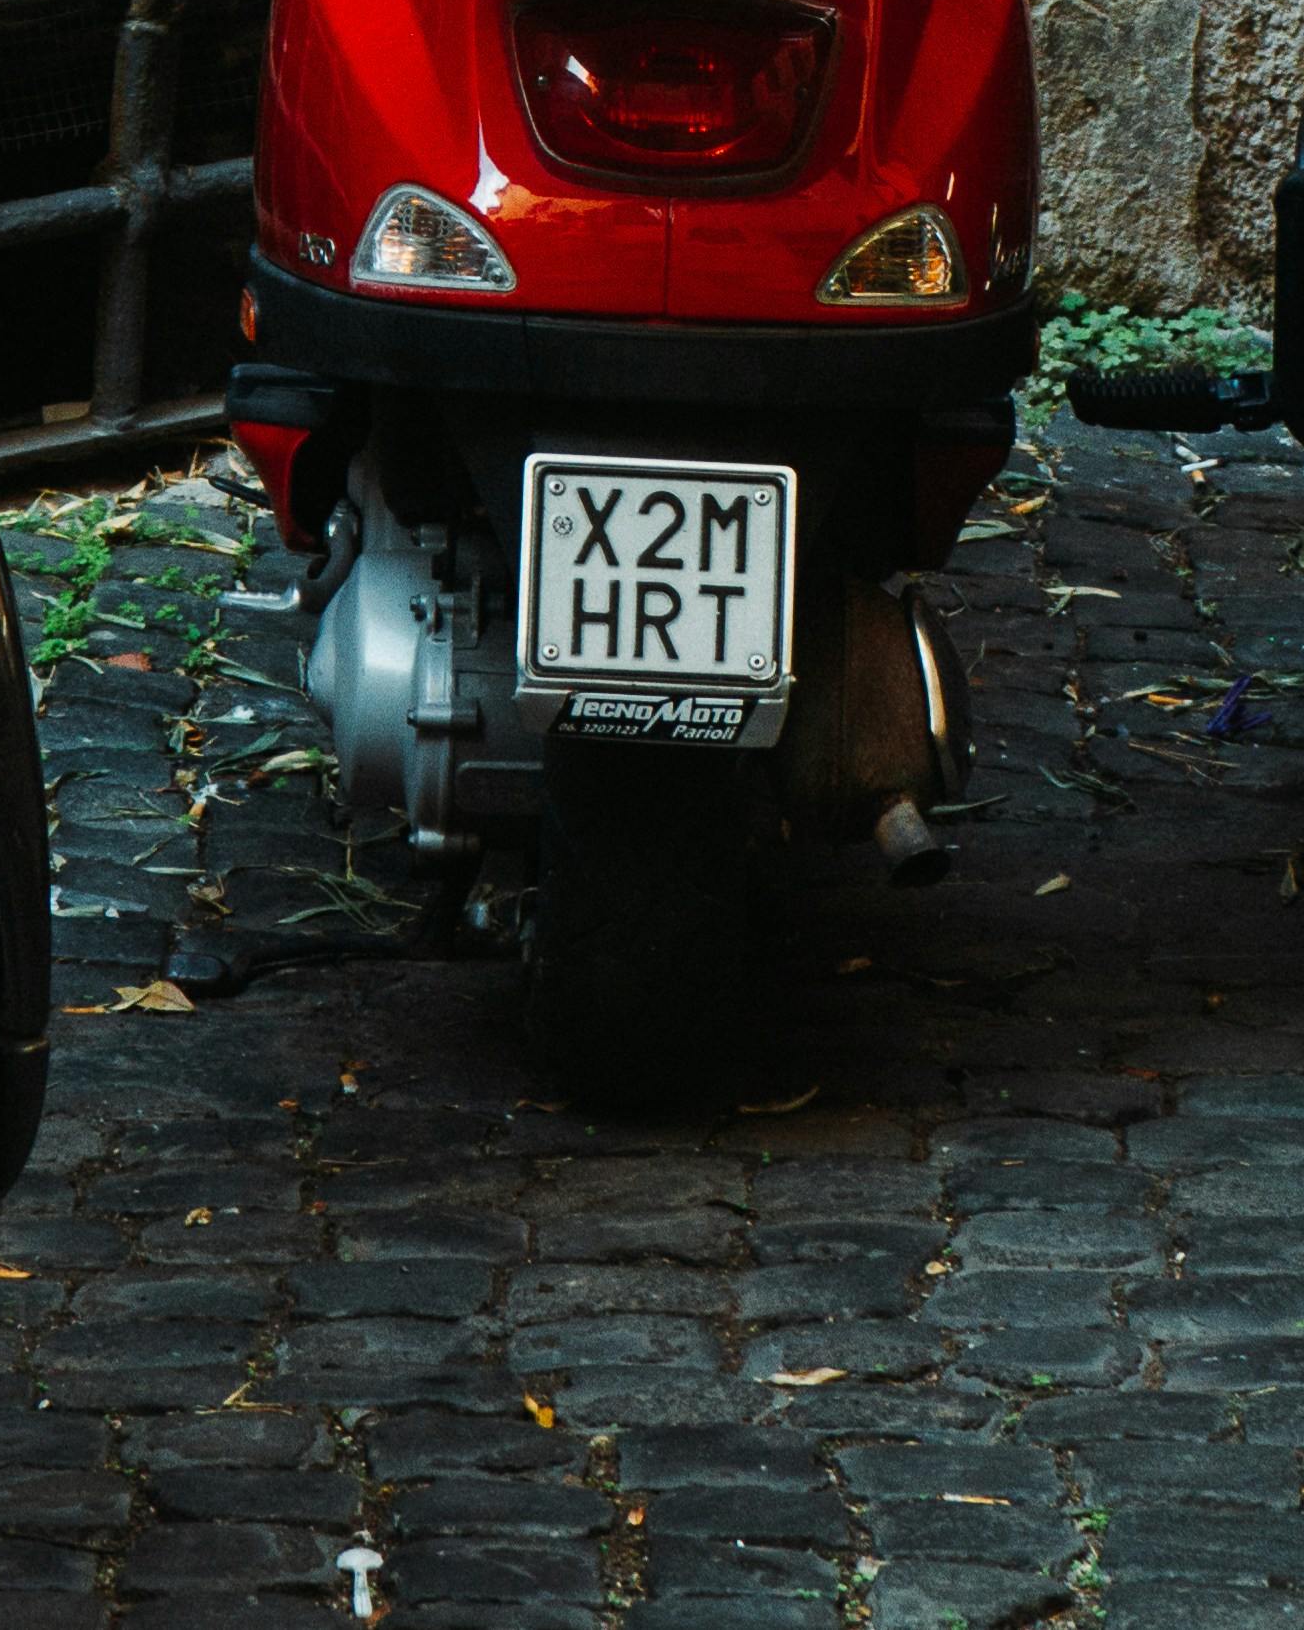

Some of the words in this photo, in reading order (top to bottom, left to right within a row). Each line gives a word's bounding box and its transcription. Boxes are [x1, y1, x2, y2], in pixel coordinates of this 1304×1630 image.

[574, 487, 749, 574] X2M
[570, 578, 746, 663] HRT
[671, 723, 738, 741] Parioli
